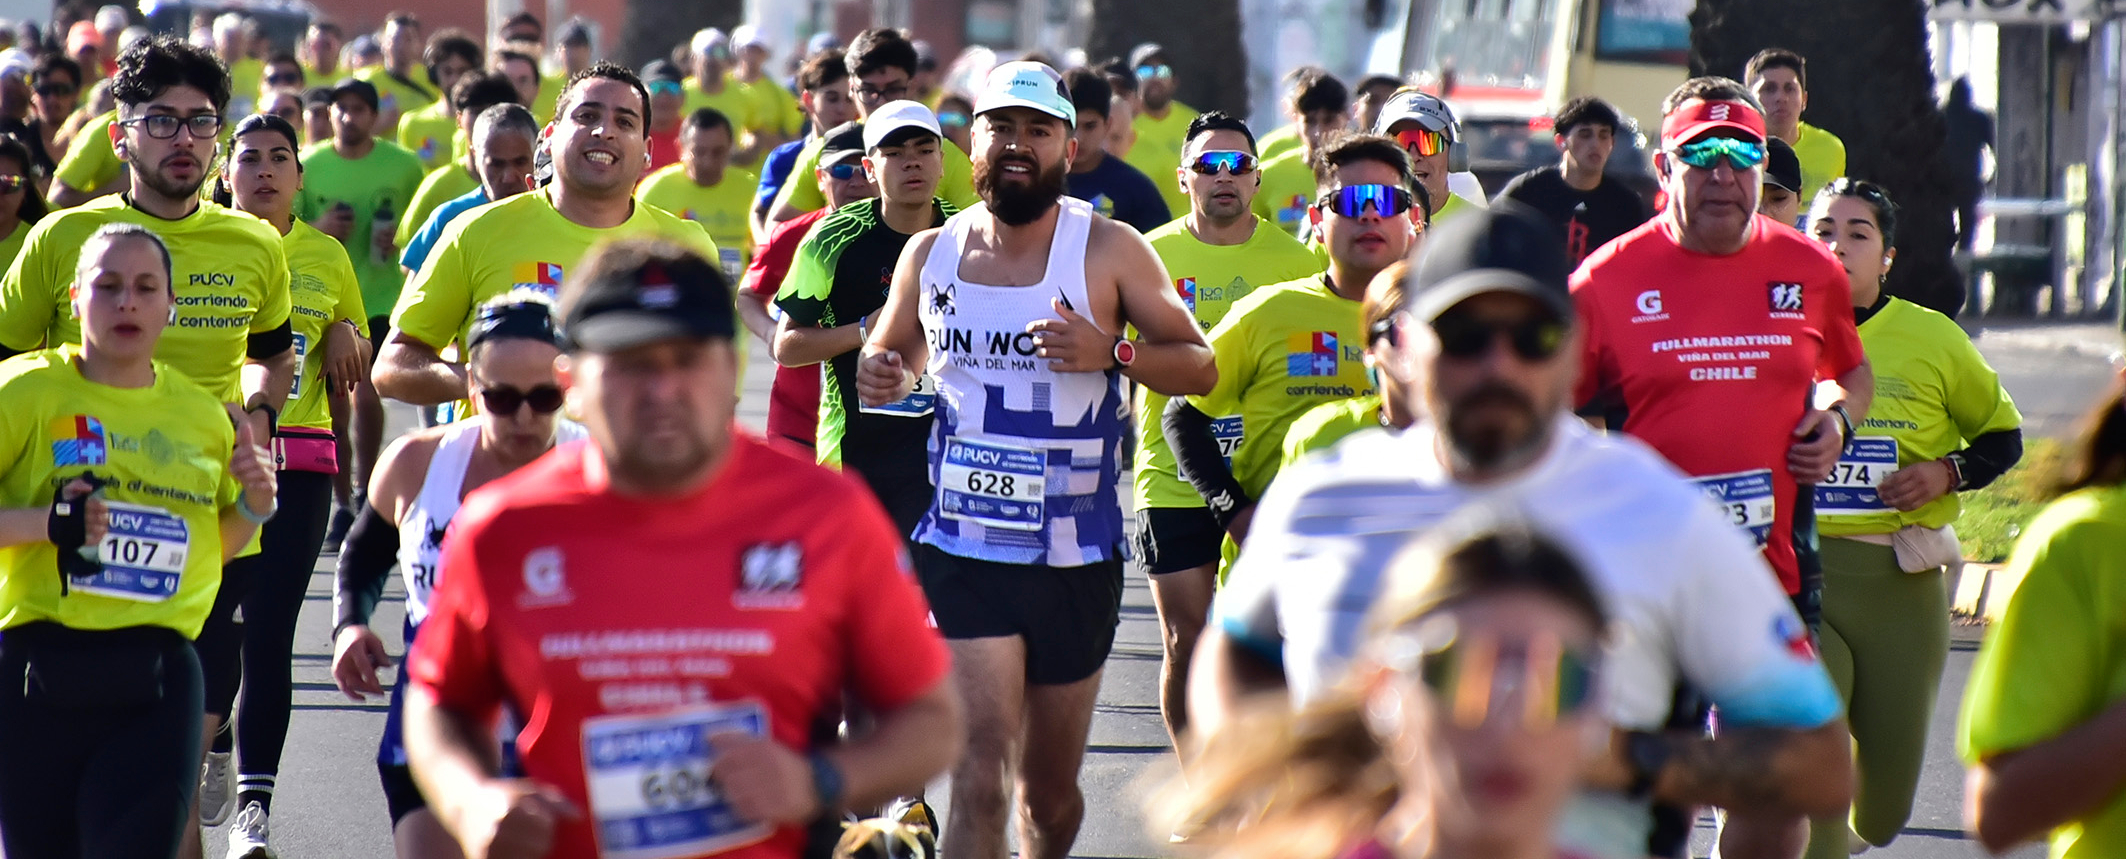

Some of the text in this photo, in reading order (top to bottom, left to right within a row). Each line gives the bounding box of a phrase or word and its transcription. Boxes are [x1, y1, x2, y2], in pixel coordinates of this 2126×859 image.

[189, 273, 234, 286] PUCV
[175, 293, 248, 308] corriendo
[1199, 287, 1223, 301] 100
[1636, 290, 1662, 314] G
[291, 304, 329, 321] ntenario
[986, 330, 1037, 356] WO
[1652, 335, 1792, 352] FULLMARATHON
[953, 354, 1036, 372] VIÑA DEL MAR
[1677, 351, 1770, 362] VIÑA DEL MAR
[1690, 366, 1757, 381] CHILE
[1286, 383, 1354, 396] corriendo
[1210, 423, 1225, 433] CV
[1862, 417, 1918, 430] ntenario
[963, 446, 1000, 466] PUCV
[967, 470, 1015, 497] 628
[1706, 483, 1728, 498] CV
[109, 512, 143, 531] UCV
[106, 538, 158, 565] 107
